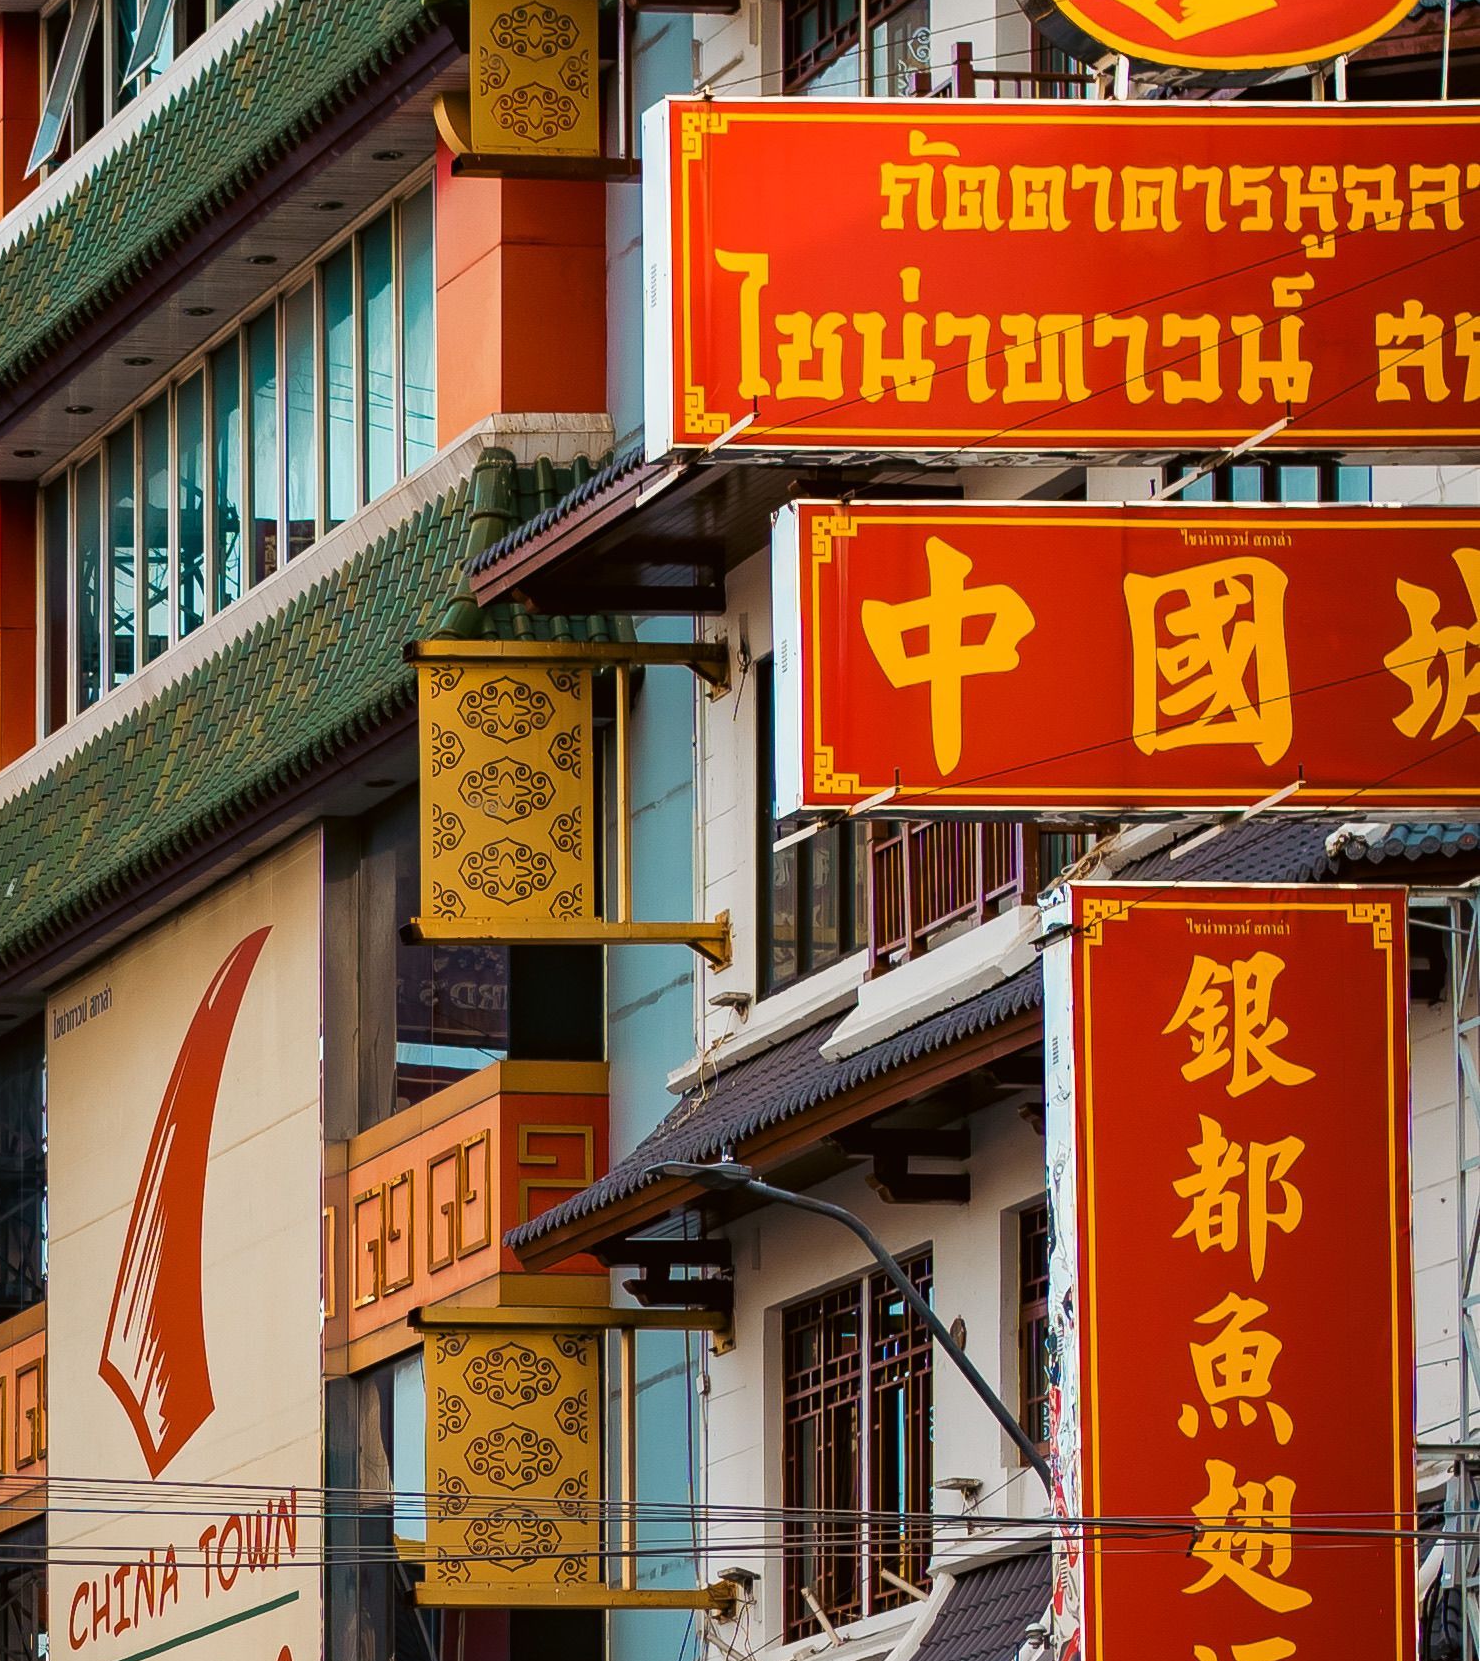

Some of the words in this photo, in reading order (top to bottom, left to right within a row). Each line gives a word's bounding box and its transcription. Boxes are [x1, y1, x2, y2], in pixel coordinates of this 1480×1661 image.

[879, 130, 1475, 259] ภัตตาคารหูฉล
[714, 247, 1316, 407] ไชน่าทาวน์
[68, 1541, 177, 1651] CHINA
[199, 1487, 299, 1595] TOWN
